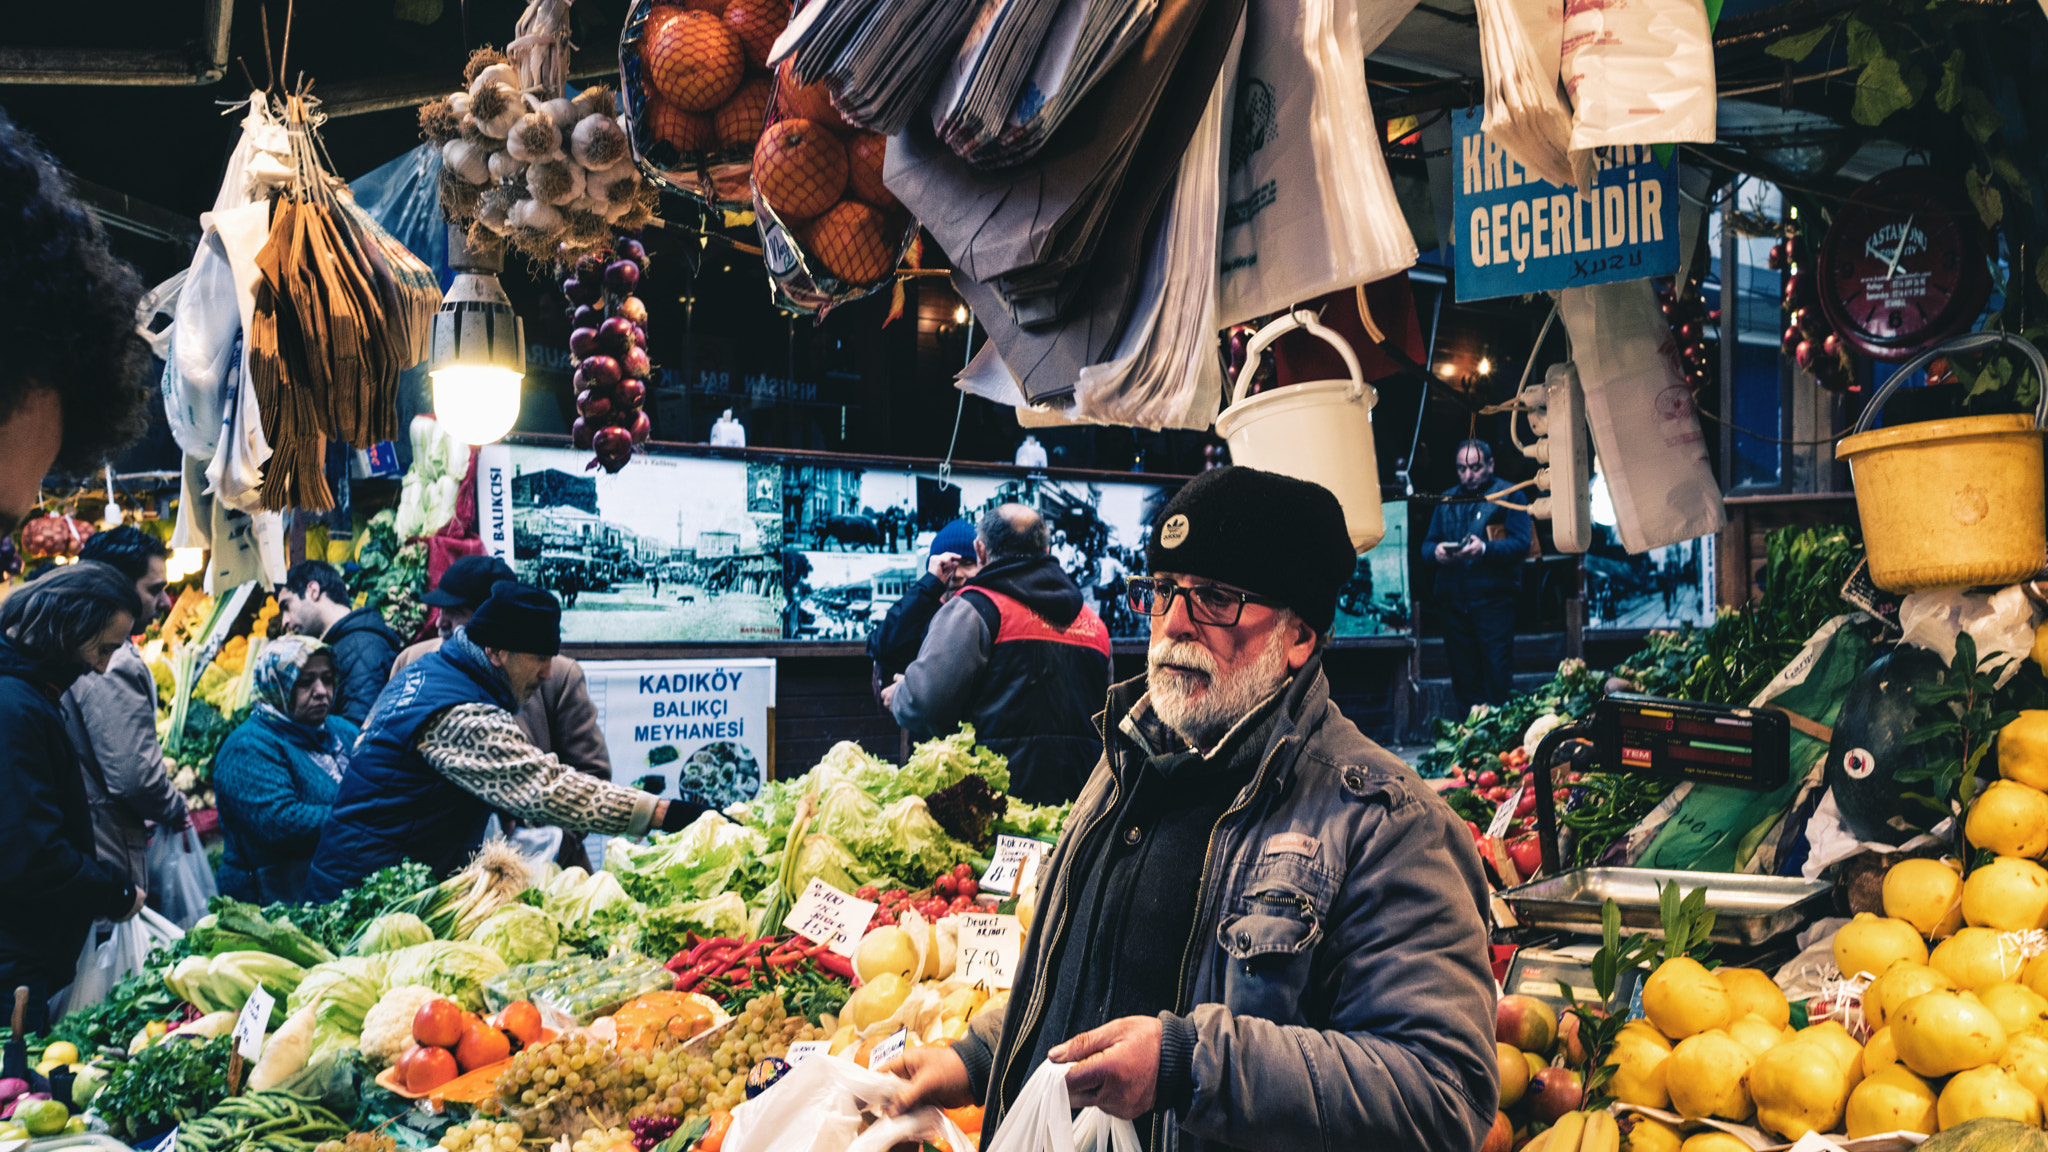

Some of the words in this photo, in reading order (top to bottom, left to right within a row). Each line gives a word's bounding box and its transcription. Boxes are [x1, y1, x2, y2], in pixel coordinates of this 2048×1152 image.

[1470, 168, 1664, 273] GEÇERLİDİR
[1567, 250, 1642, 283] KUZU
[490, 467, 506, 541] BALIKÇISI
[639, 667, 743, 694] KADIKÖY
[653, 699, 728, 719] BALIKÇI
[634, 717, 744, 742] MEYHANESİ
[1624, 748, 1650, 760] TEM
